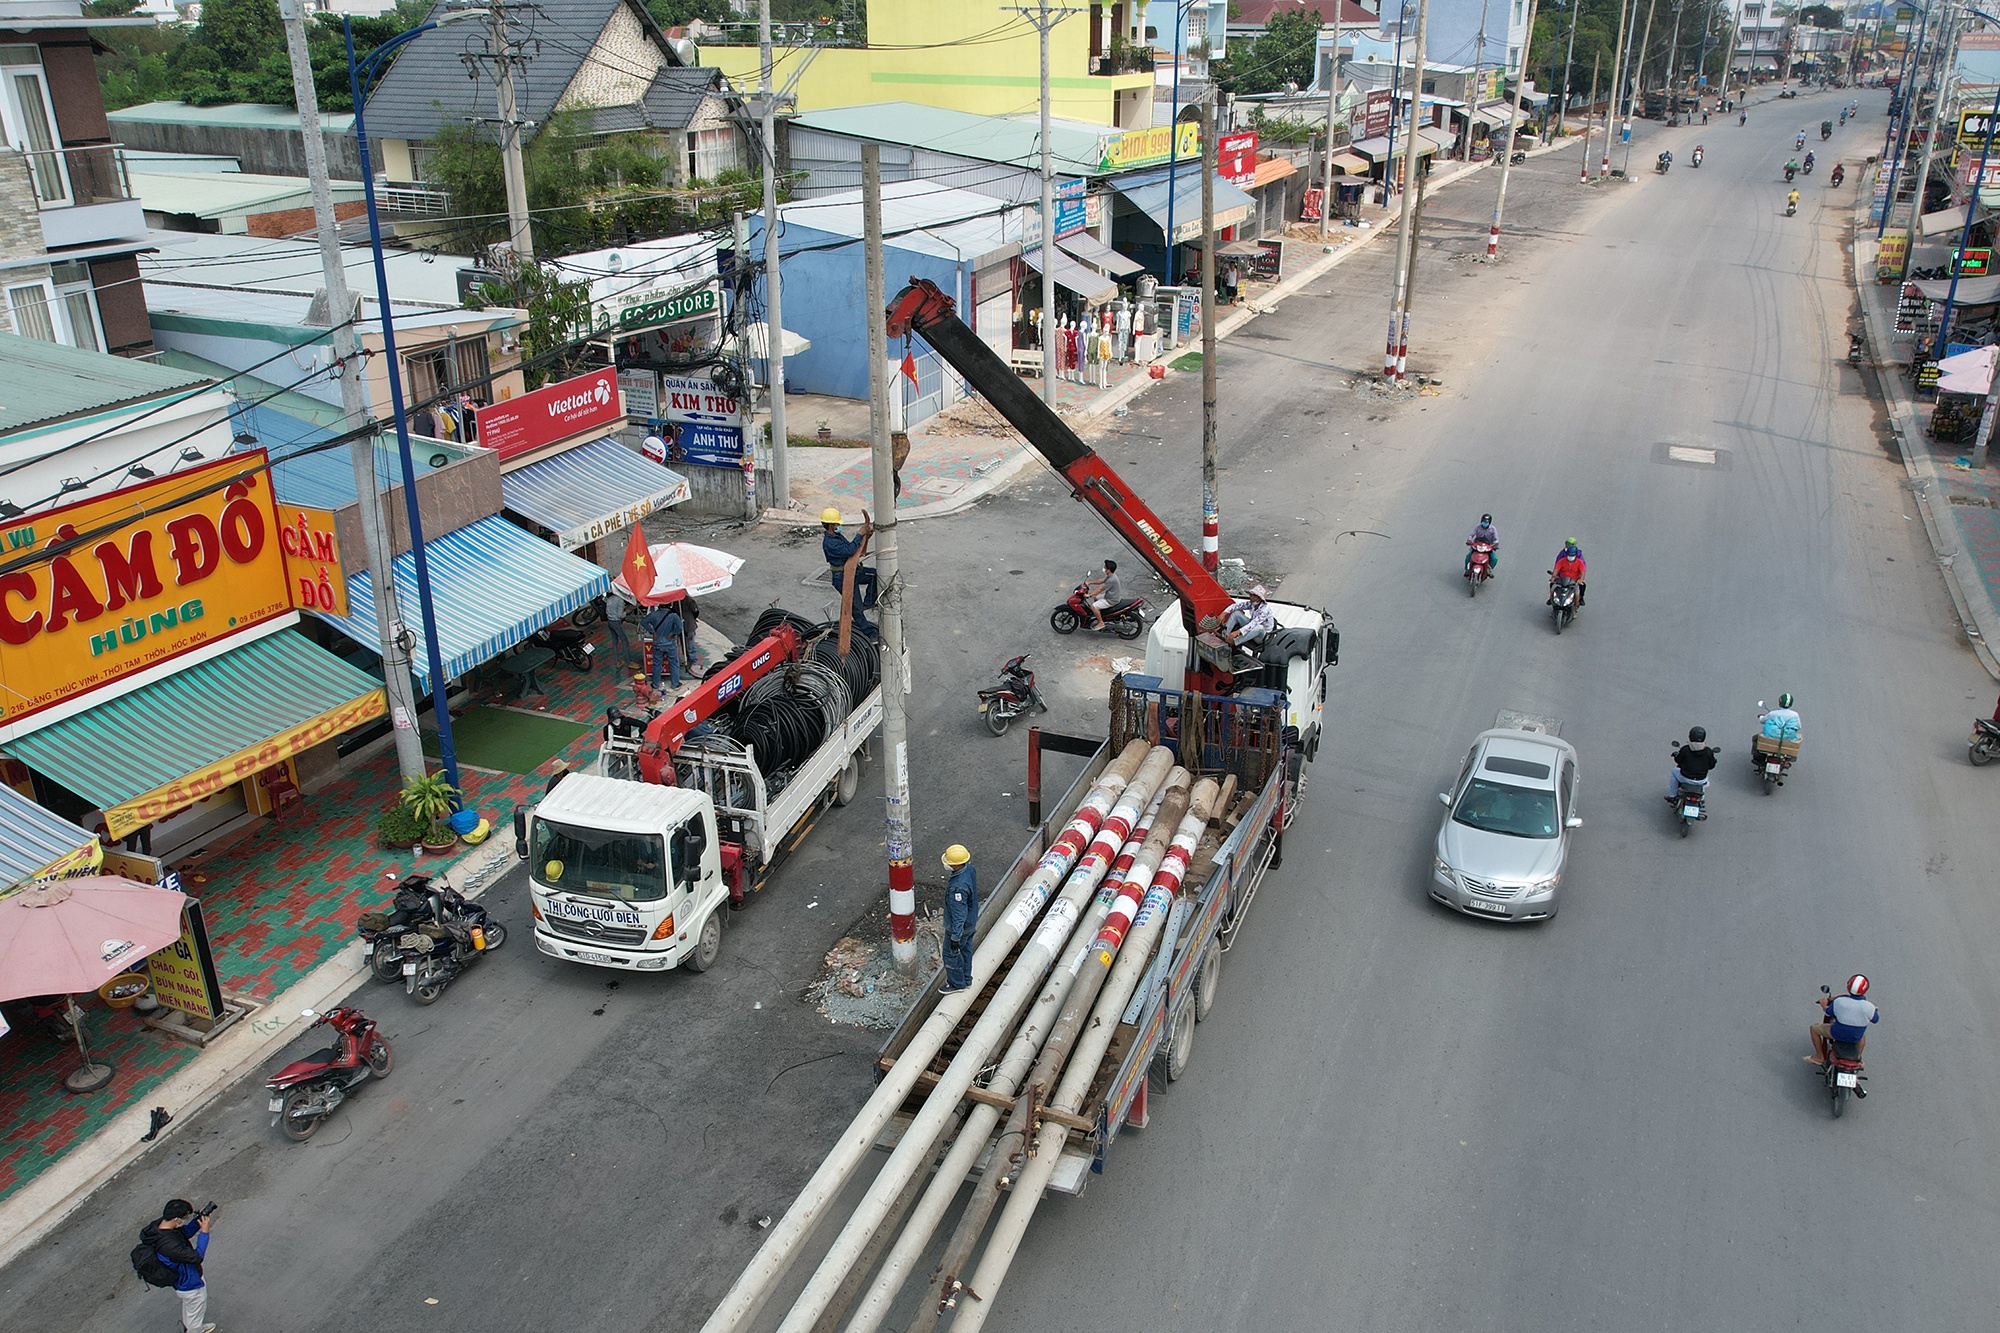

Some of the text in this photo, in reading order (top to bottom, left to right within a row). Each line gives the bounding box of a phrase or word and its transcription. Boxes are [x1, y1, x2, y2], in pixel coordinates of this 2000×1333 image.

[1122, 135, 1147, 159] BIDA
[548, 389, 593, 417] Vietlott
[671, 392, 701, 411] KIM
[693, 433, 739, 450] ANH THƯ
[166, 469, 265, 587] ĐỒ
[590, 520, 604, 539] CÀ
[605, 512, 622, 534] PHÊ
[640, 497, 652, 517] SỐ
[6, 525, 36, 550] VỤ
[281, 512, 338, 564] CẦM
[299, 566, 335, 613] ĐỒ
[239, 602, 283, 624] 09 6786 3786
[90, 598, 205, 657] HÙNG
[10, 703, 25, 715] 216
[124, 657, 141, 669] TAM
[171, 636, 188, 651] HÓC
[189, 631, 208, 646] MÔN
[752, 652, 771, 670] UNIC
[717, 673, 741, 700] 360
[137, 781, 224, 820] CẦM
[233, 739, 279, 778] ĐỒ
[290, 698, 383, 752] HÙNG
[547, 899, 562, 914] THI
[173, 936, 193, 962] GÀ
[151, 959, 175, 976] CHÁO
[155, 974, 175, 990] BÚN
